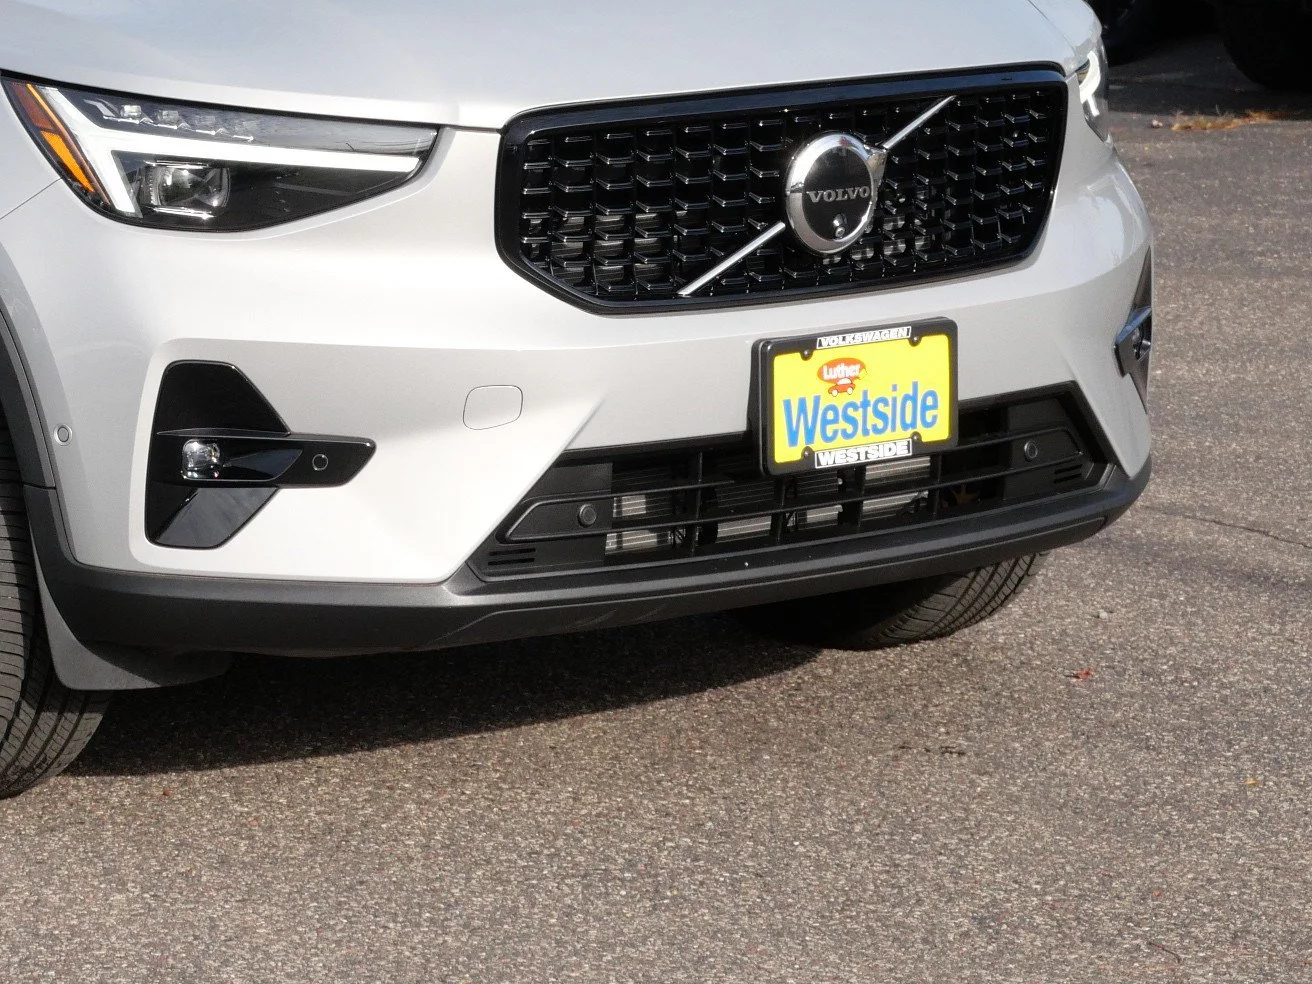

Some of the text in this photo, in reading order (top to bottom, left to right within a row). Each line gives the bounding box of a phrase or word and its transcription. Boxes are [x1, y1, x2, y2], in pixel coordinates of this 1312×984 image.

[806, 186, 871, 203] VOLVO
[819, 327, 910, 347] VOLKSWAGEN
[823, 363, 862, 380] Luther
[782, 381, 939, 448] Westside
[818, 441, 909, 466] WESTSIDE
